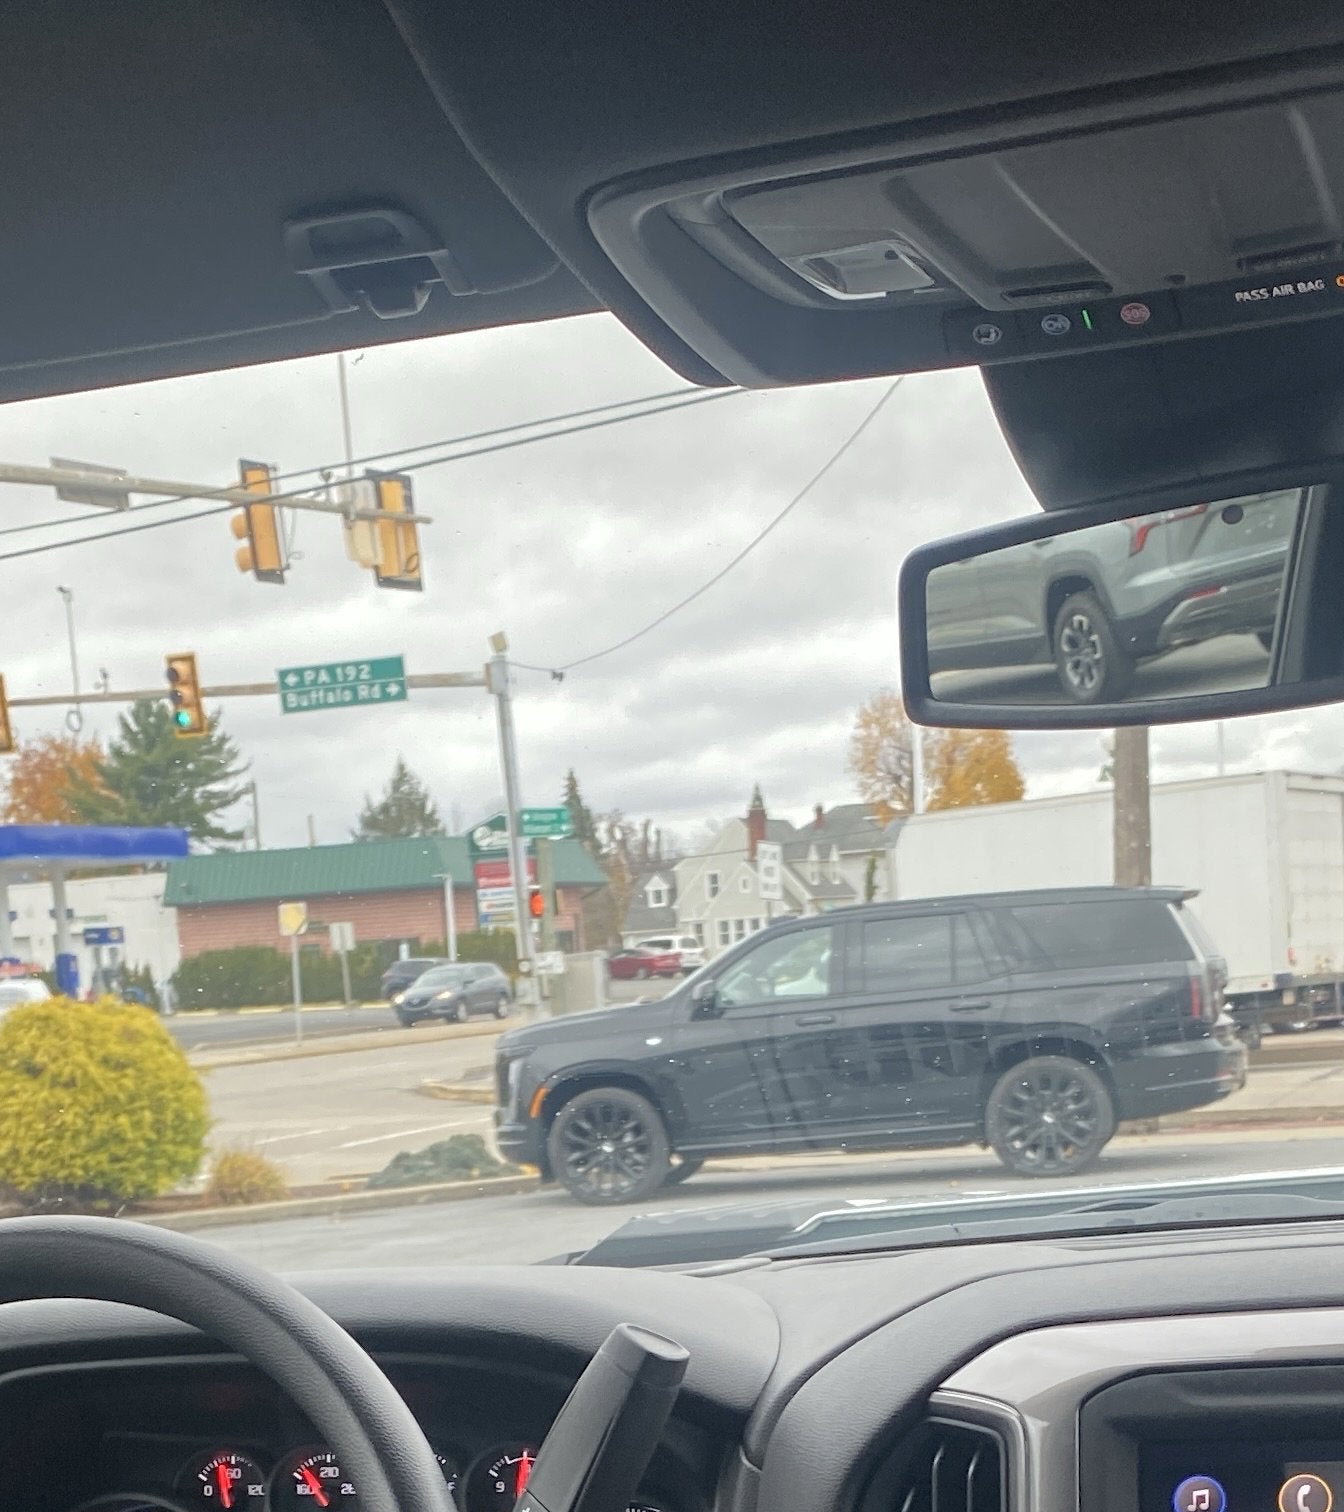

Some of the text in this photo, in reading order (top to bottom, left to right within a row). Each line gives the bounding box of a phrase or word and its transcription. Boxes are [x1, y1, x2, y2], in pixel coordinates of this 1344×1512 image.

[1236, 279, 1325, 303] PASS AIR BAG
[303, 664, 371, 685] PA 192
[286, 684, 382, 708] Buffalo Rd
[319, 1467, 340, 1479] 210
[203, 1485, 213, 1497] 0
[495, 1481, 506, 1493] 9
